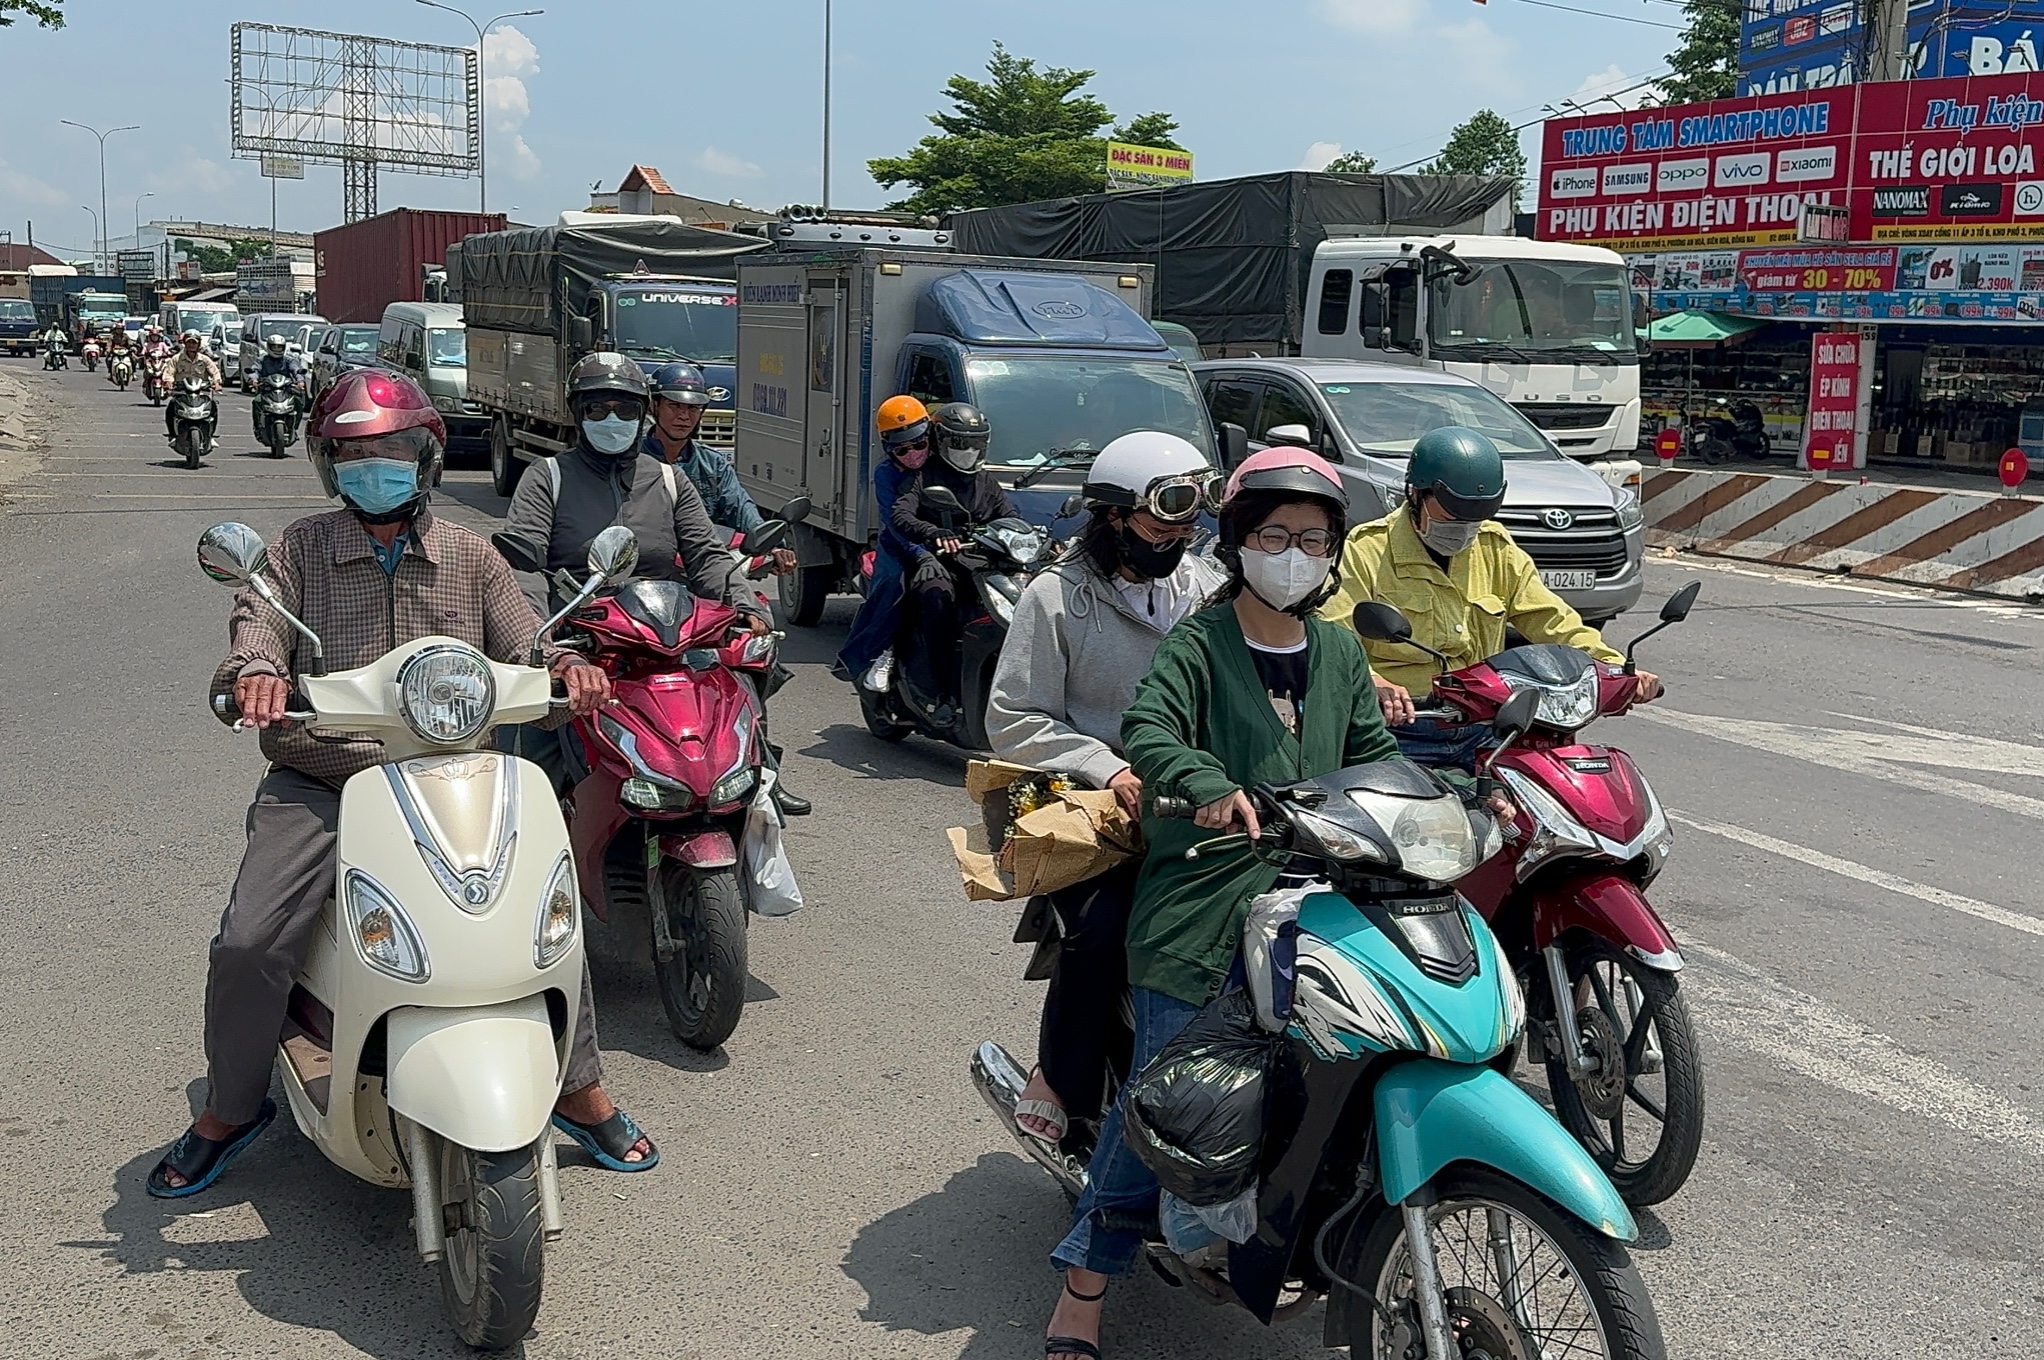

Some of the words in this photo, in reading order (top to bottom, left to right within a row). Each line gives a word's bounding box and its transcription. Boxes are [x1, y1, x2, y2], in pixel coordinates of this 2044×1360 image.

[1968, 30, 2043, 77] BÁ
[1922, 98, 1979, 135] Phụ
[1982, 93, 2044, 133] kiện
[1563, 125, 1627, 158] TRUNG
[1633, 116, 1674, 151] TÂM
[1679, 102, 1830, 147] SMARTPHONE
[1111, 147, 1132, 165] ĐẶC
[1134, 150, 1154, 166] SẢN
[1156, 155, 1163, 167] 3
[1165, 154, 1191, 170] MIỀN
[1869, 140, 1915, 179] THẾ
[1919, 141, 1977, 178] GIỚI
[1983, 144, 2035, 176] LOA
[1562, 176, 1596, 192] iPhone
[1604, 171, 1649, 187] SAMSUNG
[1658, 166, 1707, 182] oppo
[1722, 163, 1763, 179] vivo
[1873, 187, 1930, 210] NANOMAX
[1550, 208, 1597, 238] PHỤ
[1604, 199, 1664, 235] KIỆN
[1672, 195, 1737, 232] ĐIỆN
[1756, 273, 1783, 288] giảm
[1802, 268, 1828, 289] 30
[1844, 268, 1882, 289] 70%
[1930, 258, 1954, 280] 0%
[1817, 338, 1834, 365] SỬA
[1819, 374, 1830, 398] ÉP
[1831, 373, 1850, 398] KÍNH
[1832, 410, 1854, 435] THOẠI
[1403, 903, 1450, 914] HONDA
